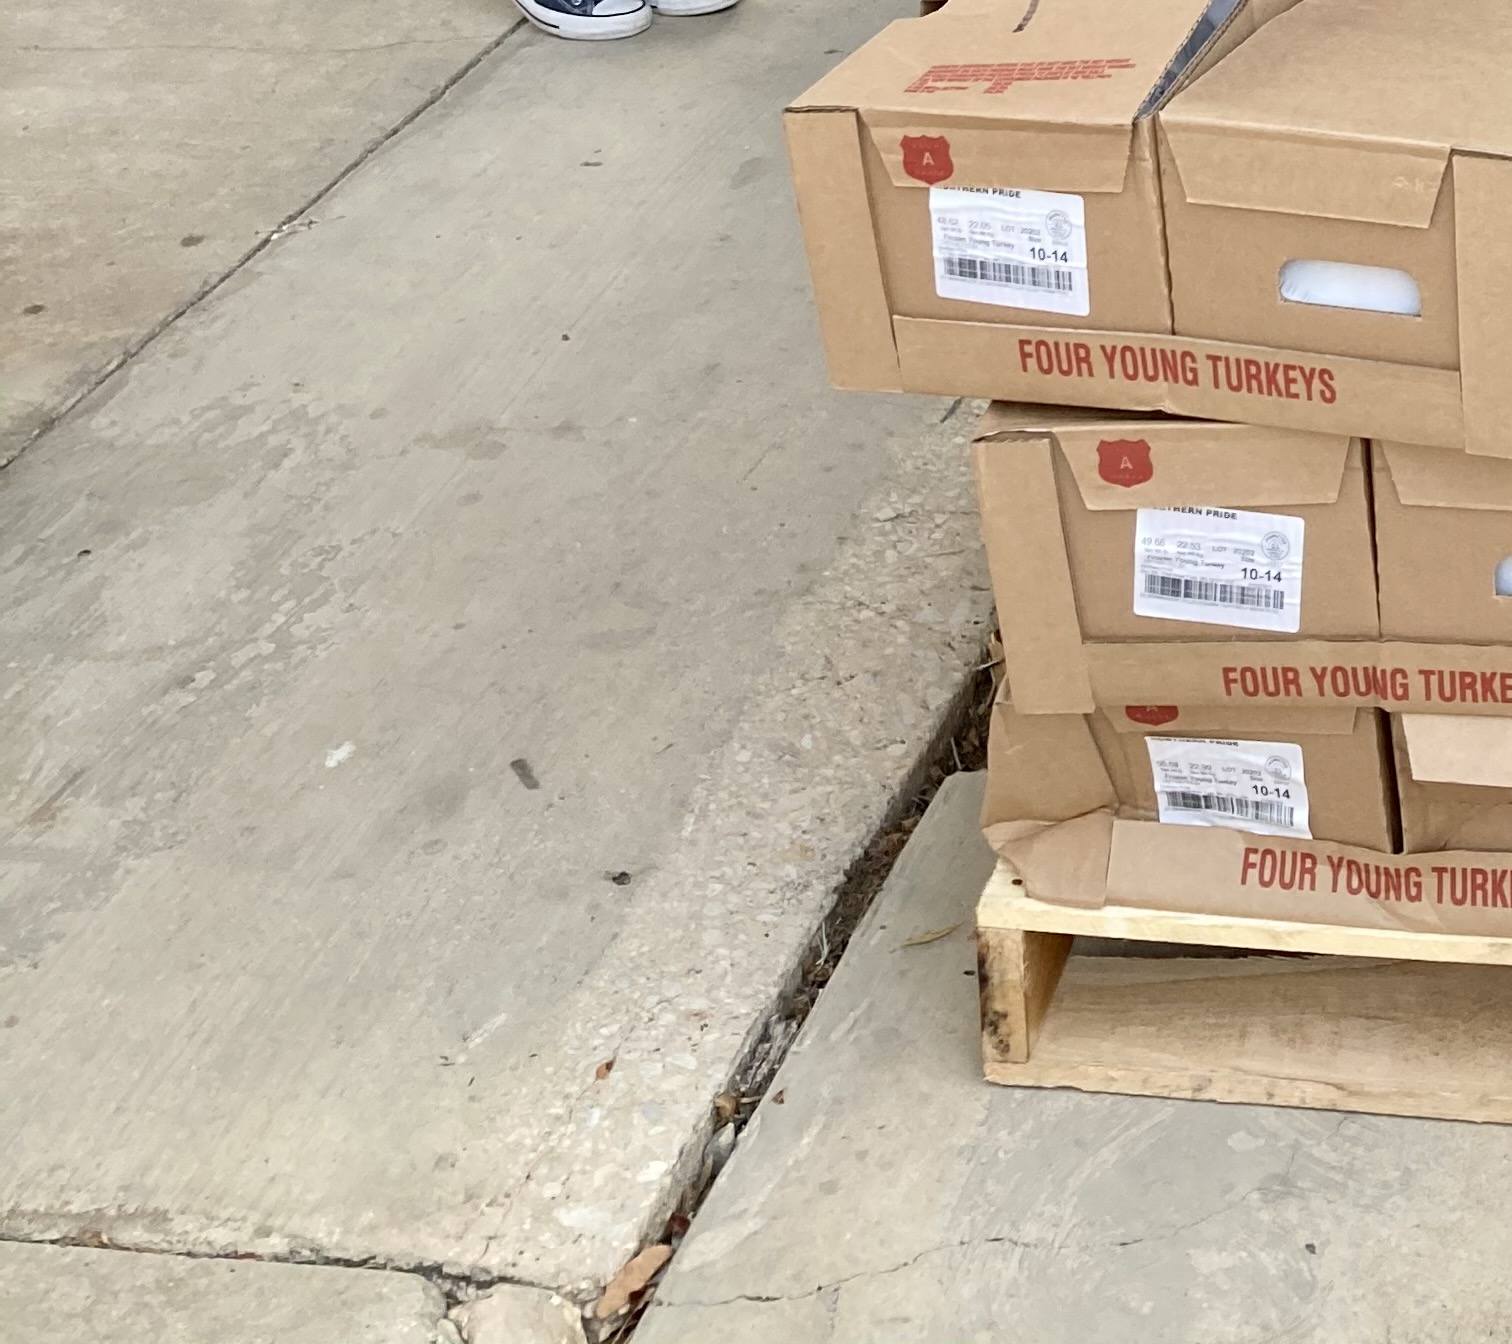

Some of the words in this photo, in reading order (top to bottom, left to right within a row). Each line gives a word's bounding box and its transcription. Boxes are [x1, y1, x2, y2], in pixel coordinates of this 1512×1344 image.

[923, 151, 935, 166] A
[992, 188, 1022, 198] PRIDE
[1029, 246, 1069, 264] 10-14
[1018, 339, 1095, 378] FOUR
[1100, 345, 1200, 387] YOUNG
[1206, 354, 1338, 405] TURKEYS
[1119, 455, 1134, 470] A
[1205, 508, 1238, 520] PRIDE
[1240, 566, 1283, 583] 10-14
[1223, 666, 1303, 699] FOUR
[1311, 666, 1410, 703] YOUNG
[1251, 784, 1291, 800] 10-14
[1241, 848, 1319, 892] FOUR
[1328, 857, 1424, 904] YOUNG
